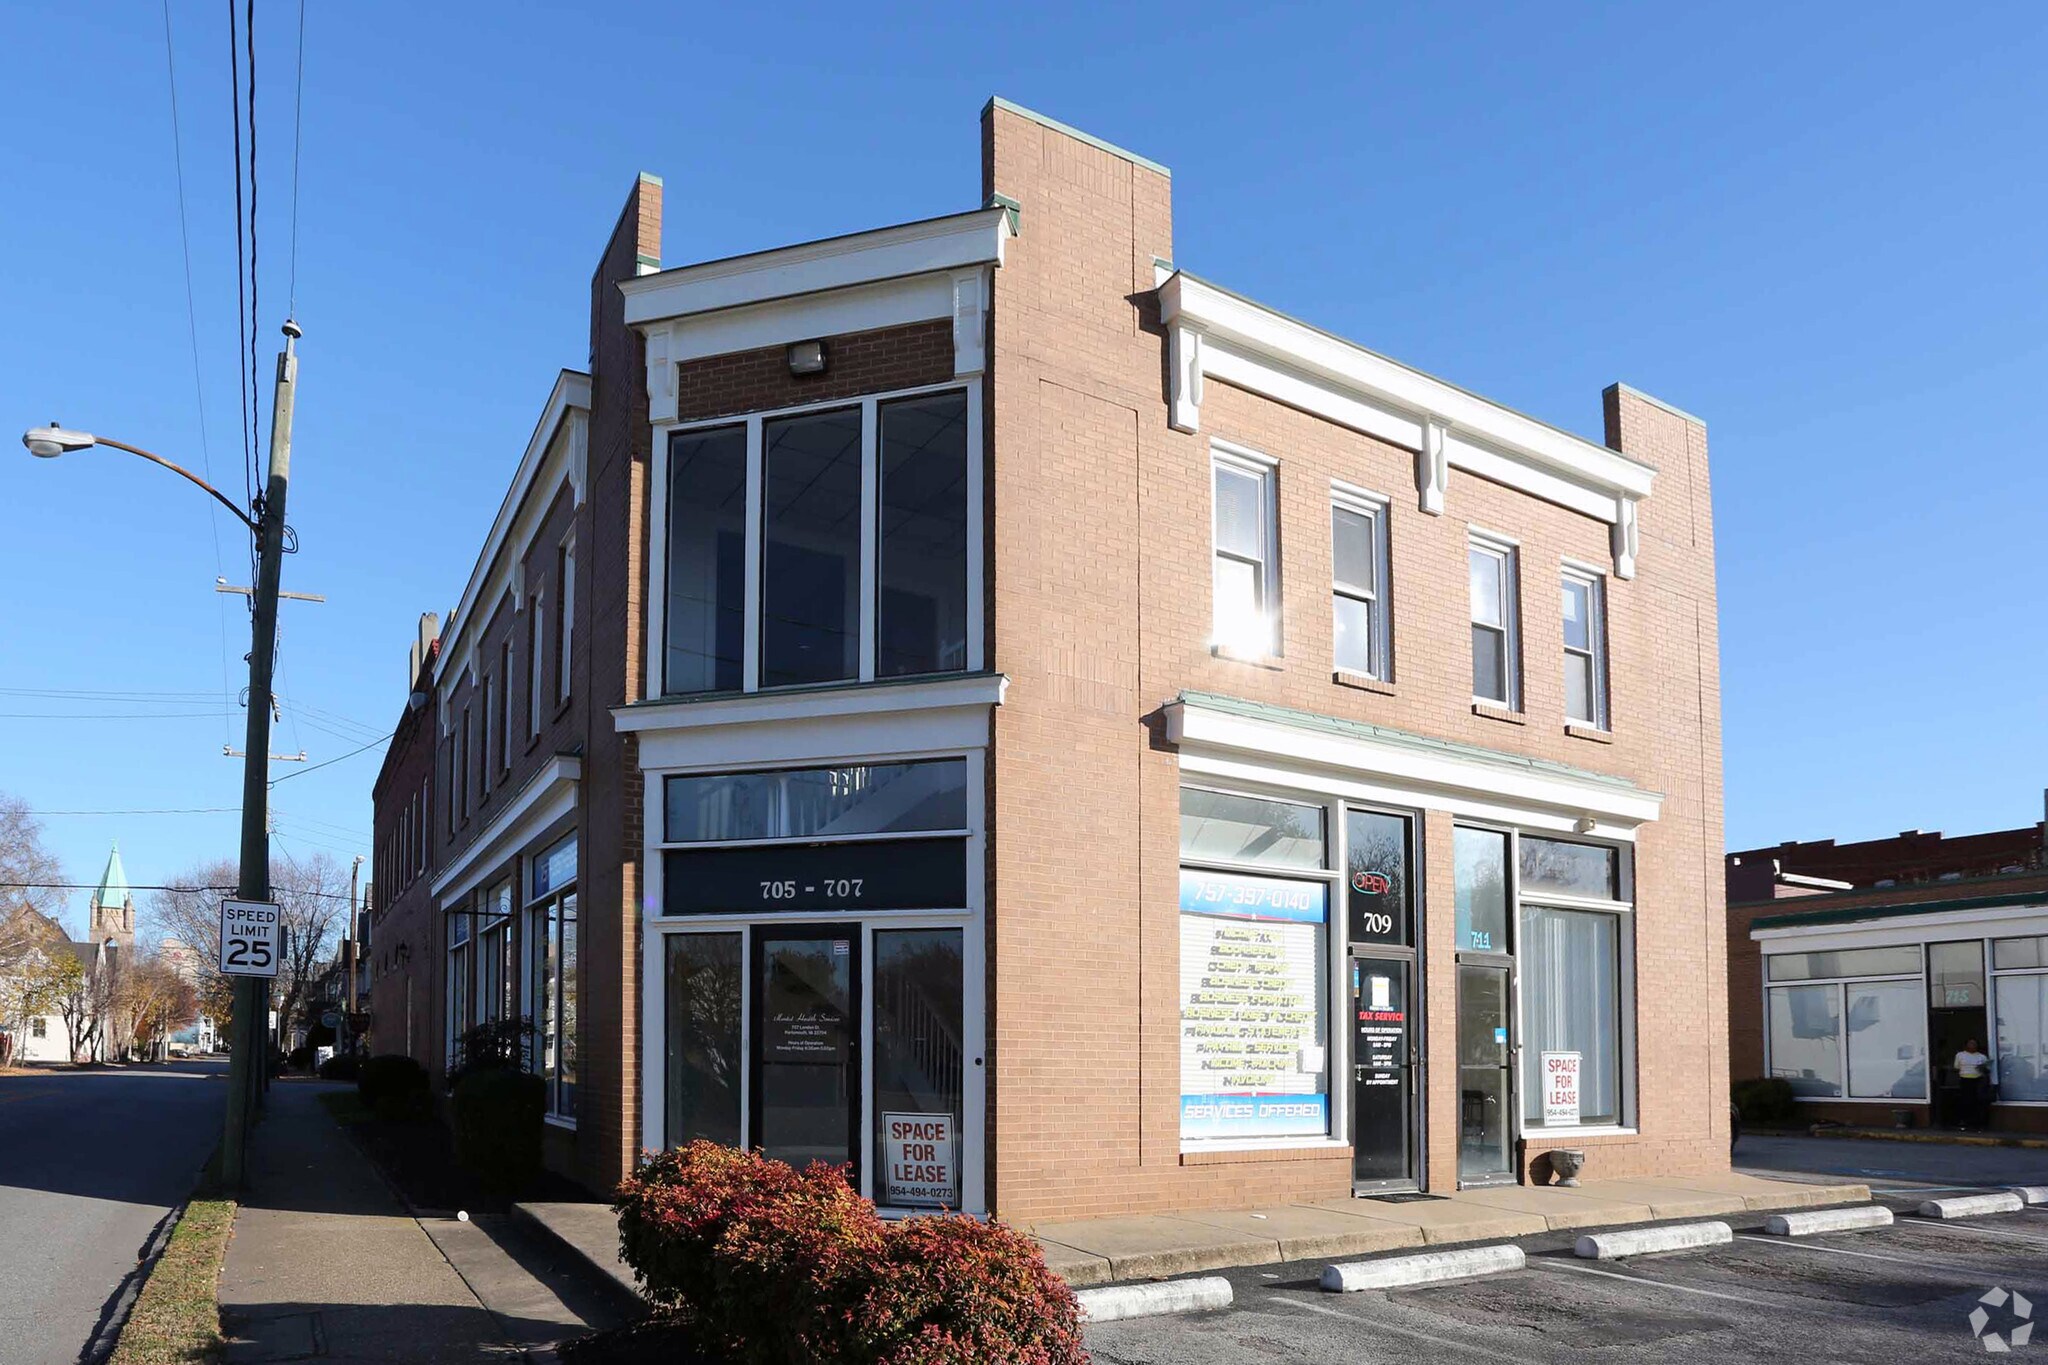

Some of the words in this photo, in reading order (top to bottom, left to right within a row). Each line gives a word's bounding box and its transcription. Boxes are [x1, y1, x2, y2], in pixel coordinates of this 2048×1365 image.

[760, 881, 796, 899] 705
[823, 879, 863, 897] 707
[1354, 871, 1389, 895] OPEN
[1194, 882, 1312, 911] 757-397-0140
[226, 908, 276, 923] SPEED
[1363, 911, 1392, 935] 709
[231, 924, 270, 938] LIMIT
[1470, 931, 1492, 949] 711
[227, 938, 272, 967] 25
[1359, 1011, 1374, 1021] TAX
[1375, 1012, 1405, 1022] SERVICE
[1548, 1058, 1577, 1073] SPACE
[1555, 1075, 1573, 1088] FOR
[1549, 1091, 1577, 1105] LEASE
[1183, 1103, 1254, 1119] SERVICES
[1259, 1103, 1321, 1118] OFFERED
[892, 1122, 946, 1141] SPACE
[903, 1143, 936, 1162] FOR
[894, 1163, 948, 1183] LEASE
[889, 1185, 954, 1198] 954-494-0273
